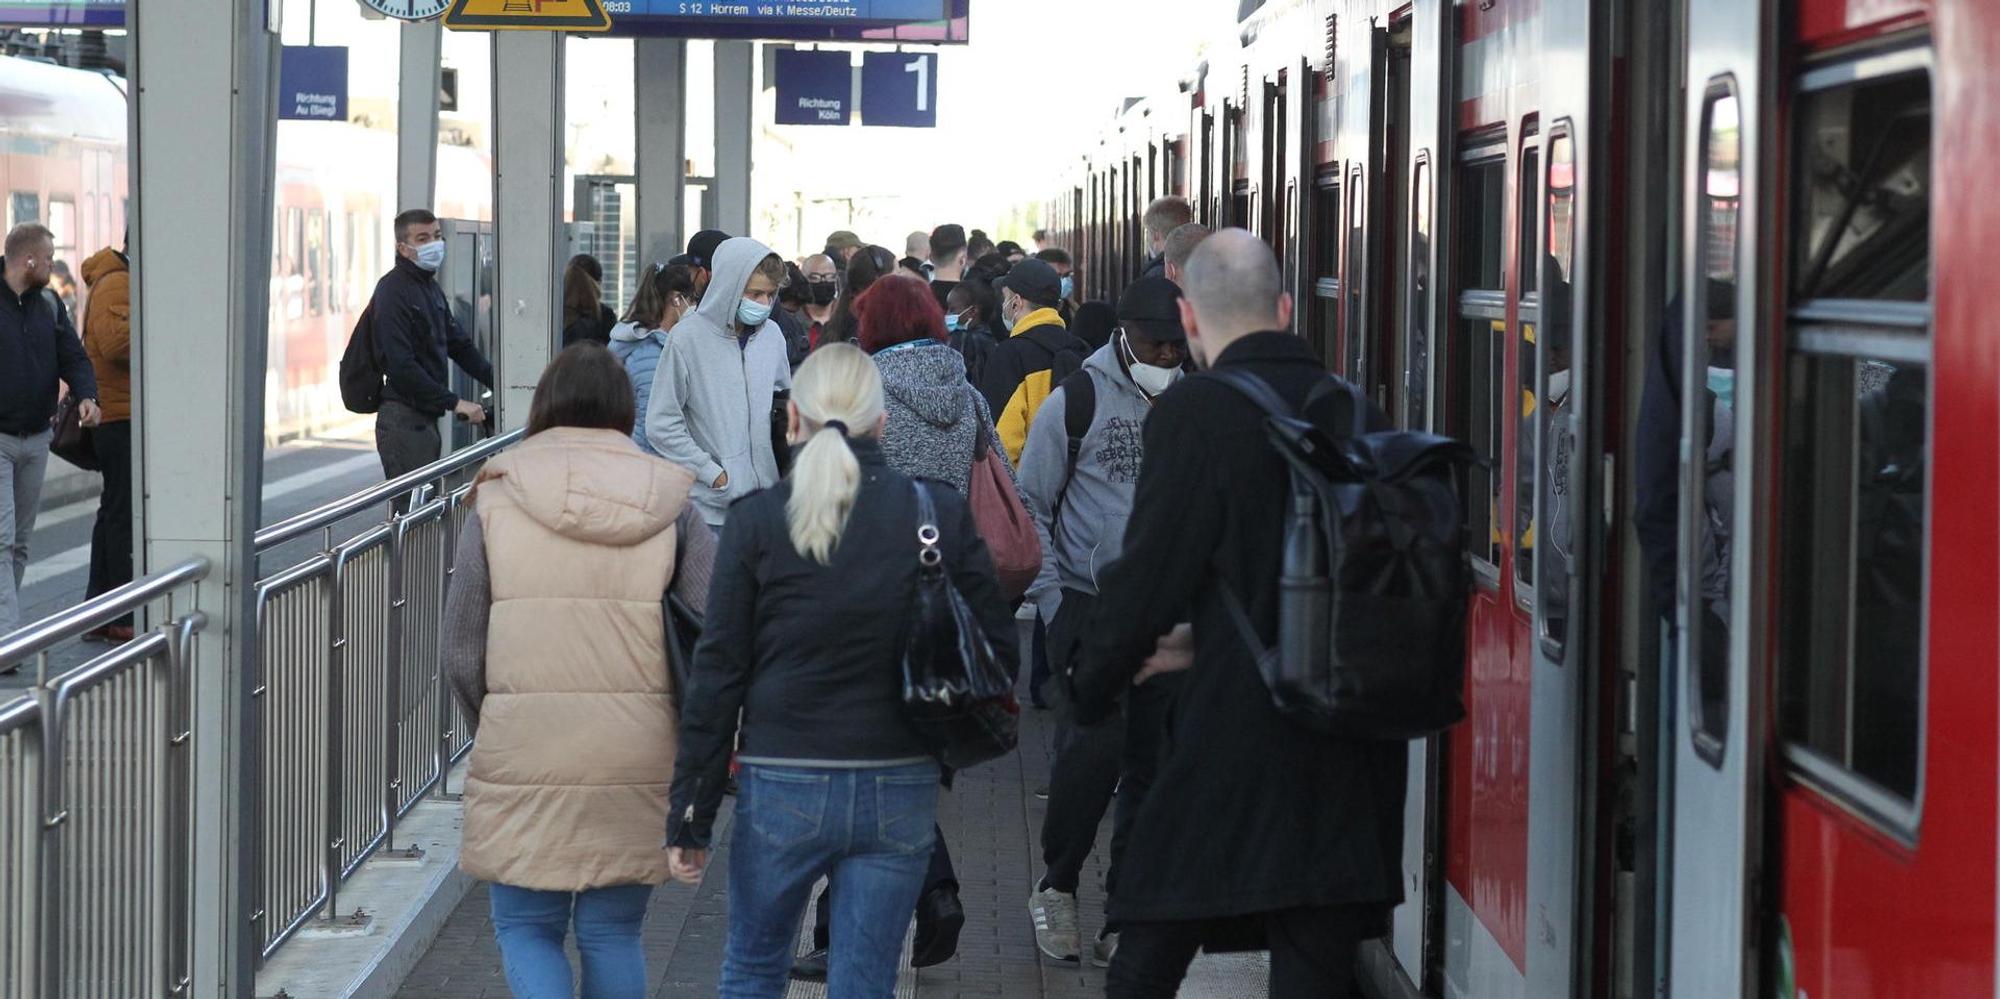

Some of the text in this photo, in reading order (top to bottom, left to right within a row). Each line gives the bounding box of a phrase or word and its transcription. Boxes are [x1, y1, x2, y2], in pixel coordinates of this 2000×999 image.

[602, 1, 857, 17] 08:03 S 12 Horrem via K Messe/Deutz
[904, 55, 928, 111] 1
[799, 97, 841, 111] Richtung
[818, 110, 841, 120] Köln
